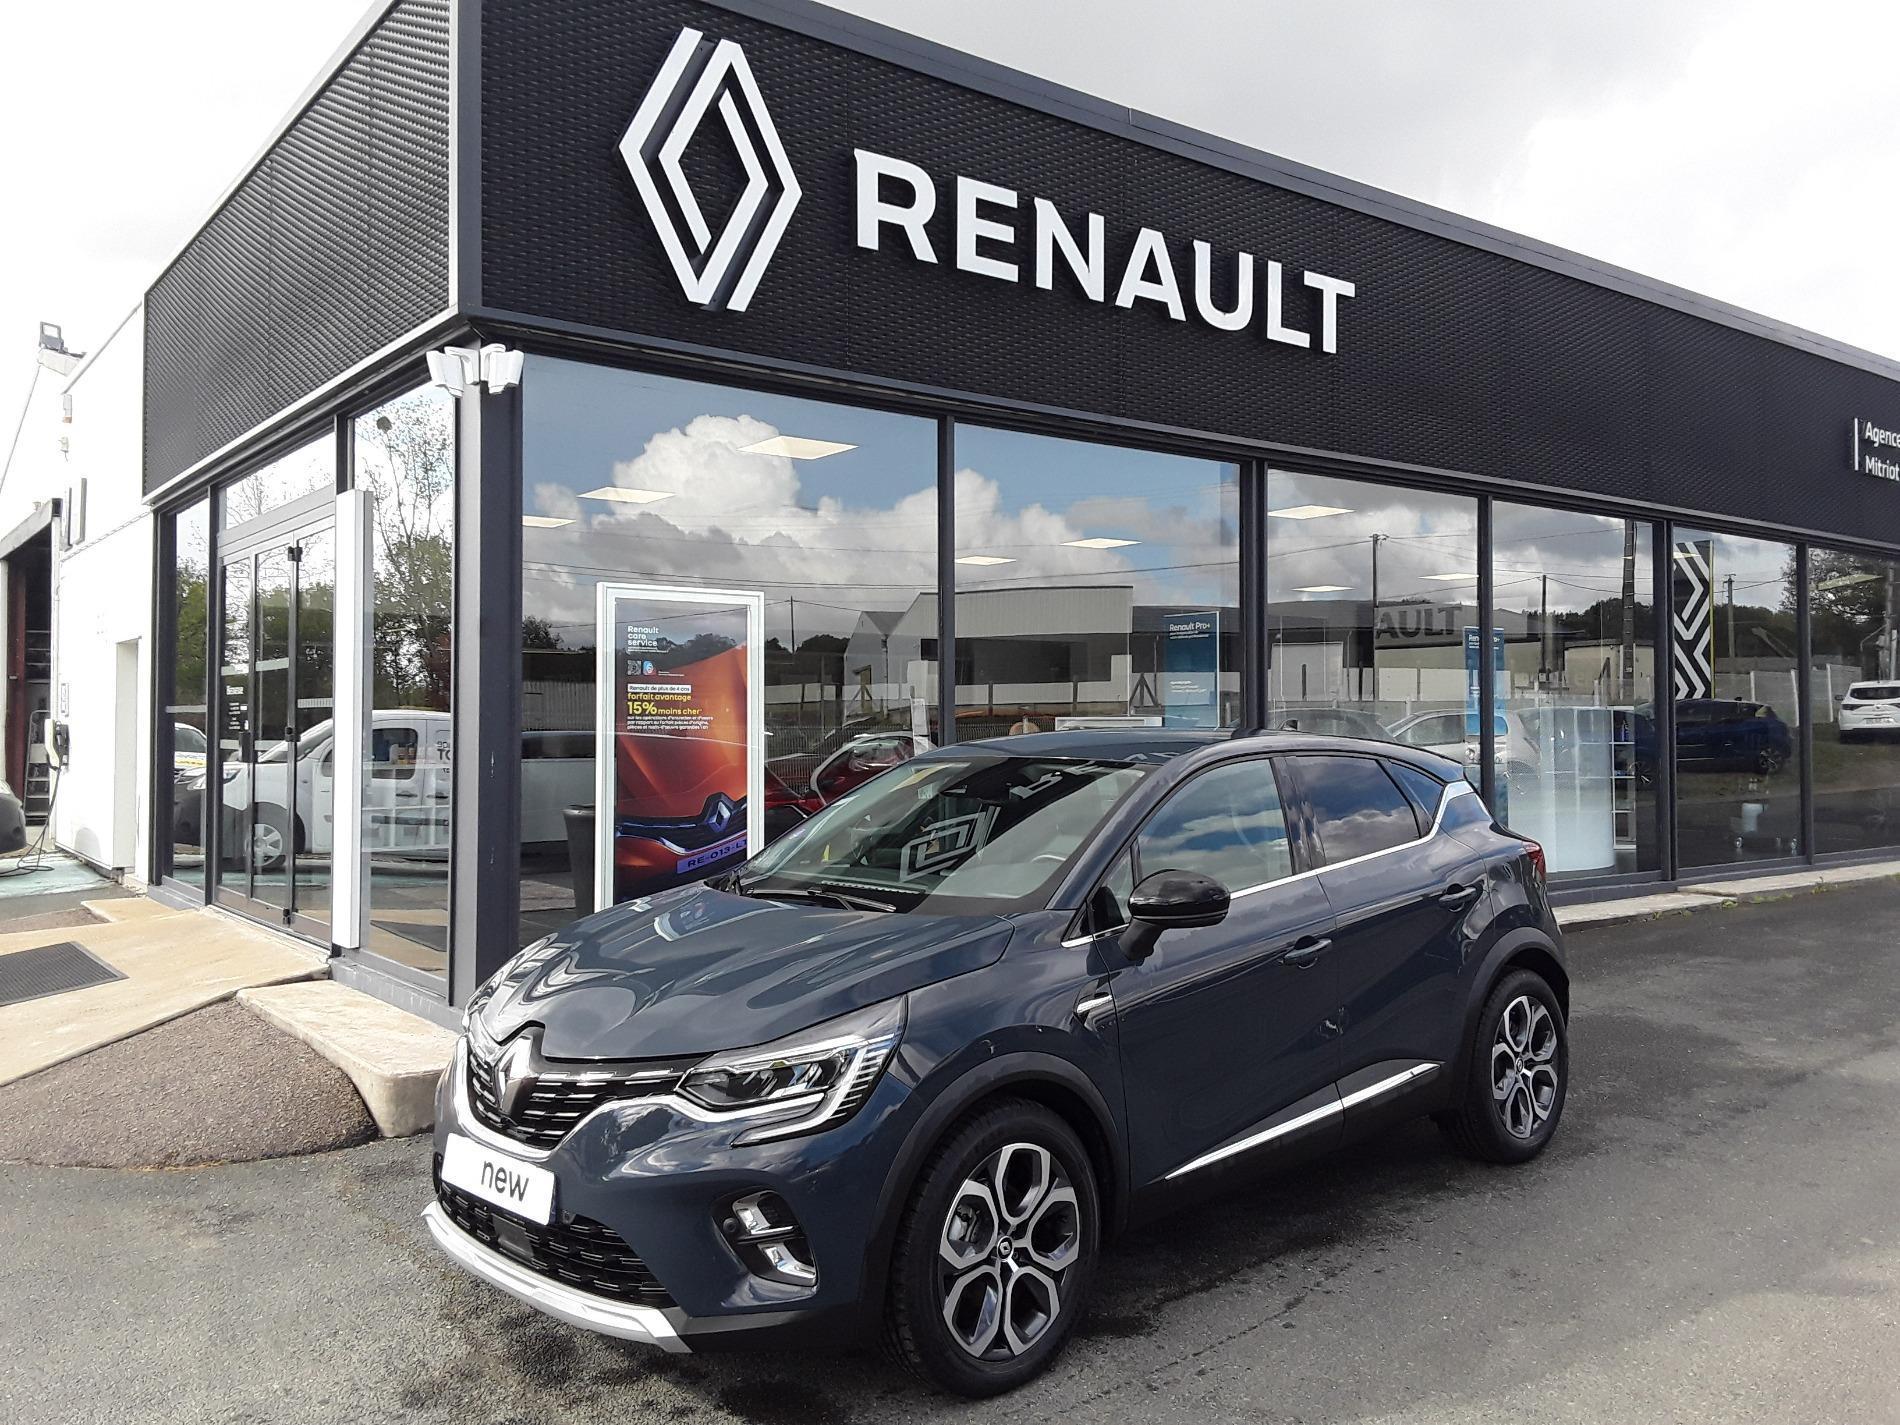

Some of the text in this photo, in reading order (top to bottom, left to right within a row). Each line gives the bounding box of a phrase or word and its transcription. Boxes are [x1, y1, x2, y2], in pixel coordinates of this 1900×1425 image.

[854, 148, 1356, 354] RENAULT
[1865, 455, 1900, 481] Mitriot
[627, 625, 659, 634] Renault
[1169, 621, 1211, 632] Renault Pro+
[627, 639, 658, 647] service
[627, 692, 692, 702] forfait avantage
[627, 701, 657, 715] 15%
[657, 707, 682, 715] moins
[481, 1160, 530, 1202] new
